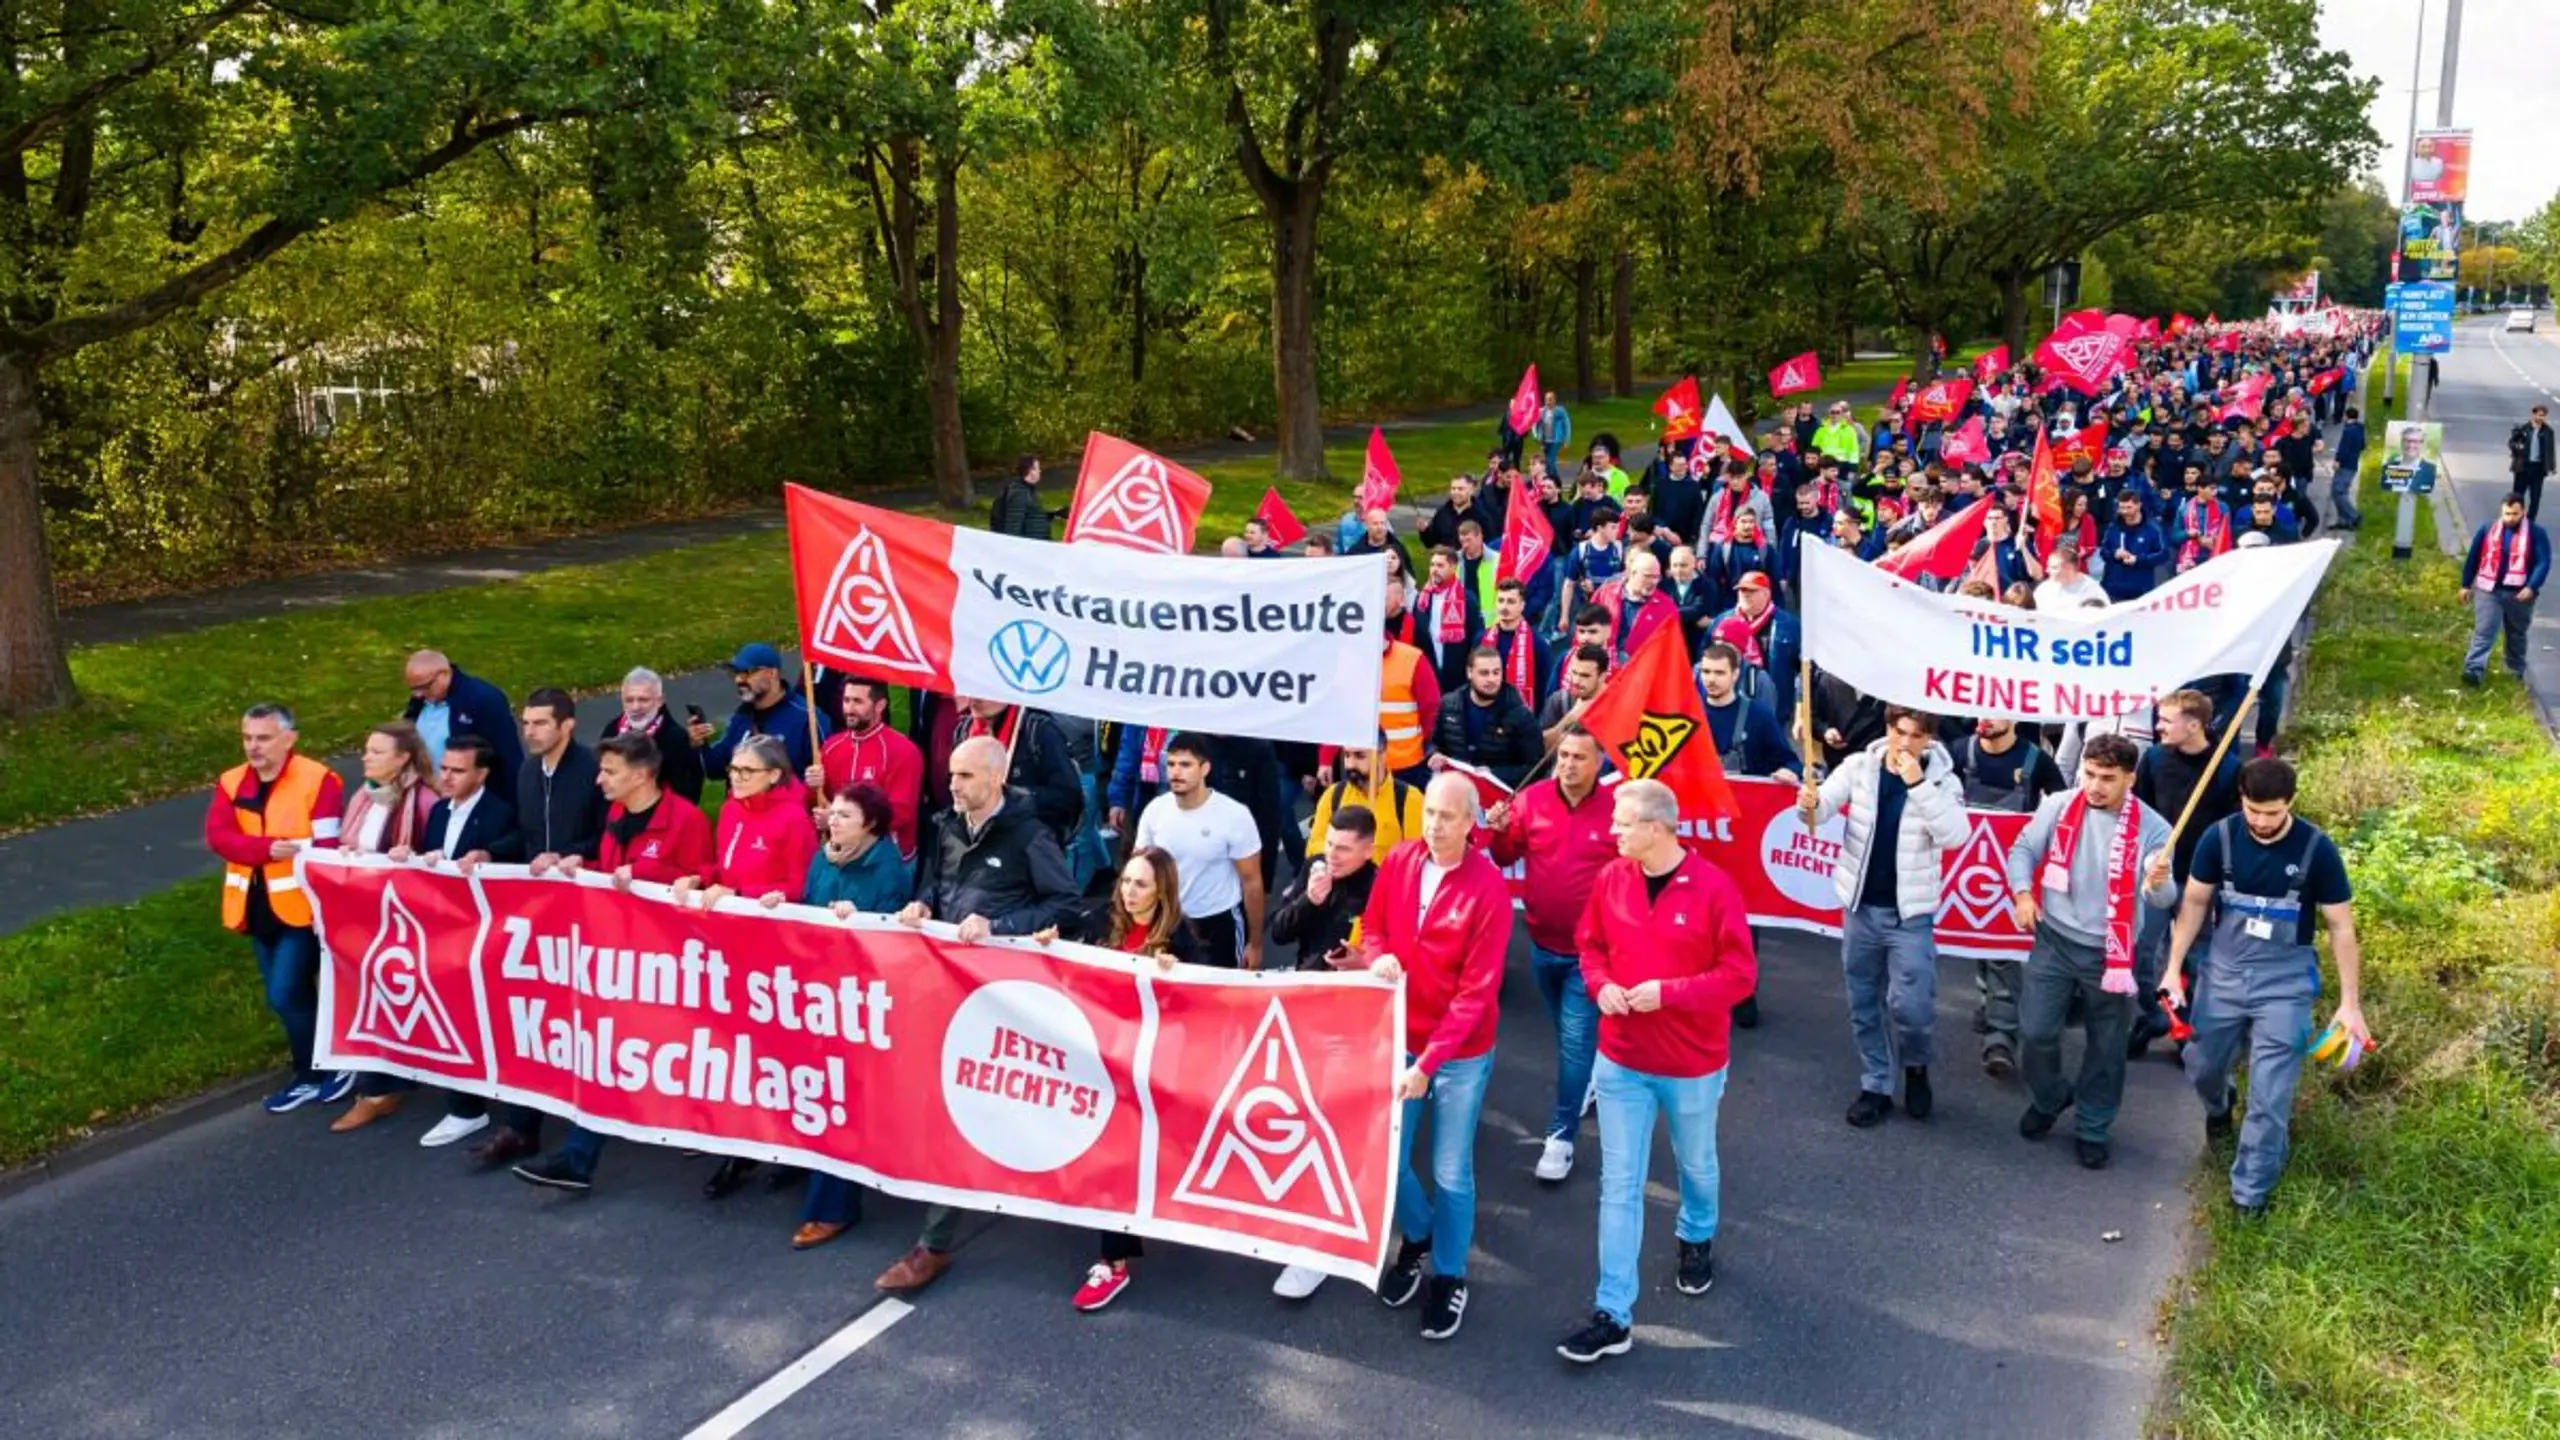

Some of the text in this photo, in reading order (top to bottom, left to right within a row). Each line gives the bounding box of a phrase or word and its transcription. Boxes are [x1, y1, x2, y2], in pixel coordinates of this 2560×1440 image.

[972, 567, 1365, 634] Vertrauensleute
[1972, 623, 2132, 667] IHR seid
[1084, 647, 1317, 704] Hannover
[1924, 667, 2158, 717] KEINE Nutzi
[1770, 849, 1836, 878] REICHT
[1791, 832, 1841, 859] JETZT
[502, 916, 892, 1049] Zukunft statt
[509, 996, 847, 1136] Kahlschlag!
[990, 1025, 1067, 1071] JETZT
[955, 1057, 1100, 1119] REICHT'S!
